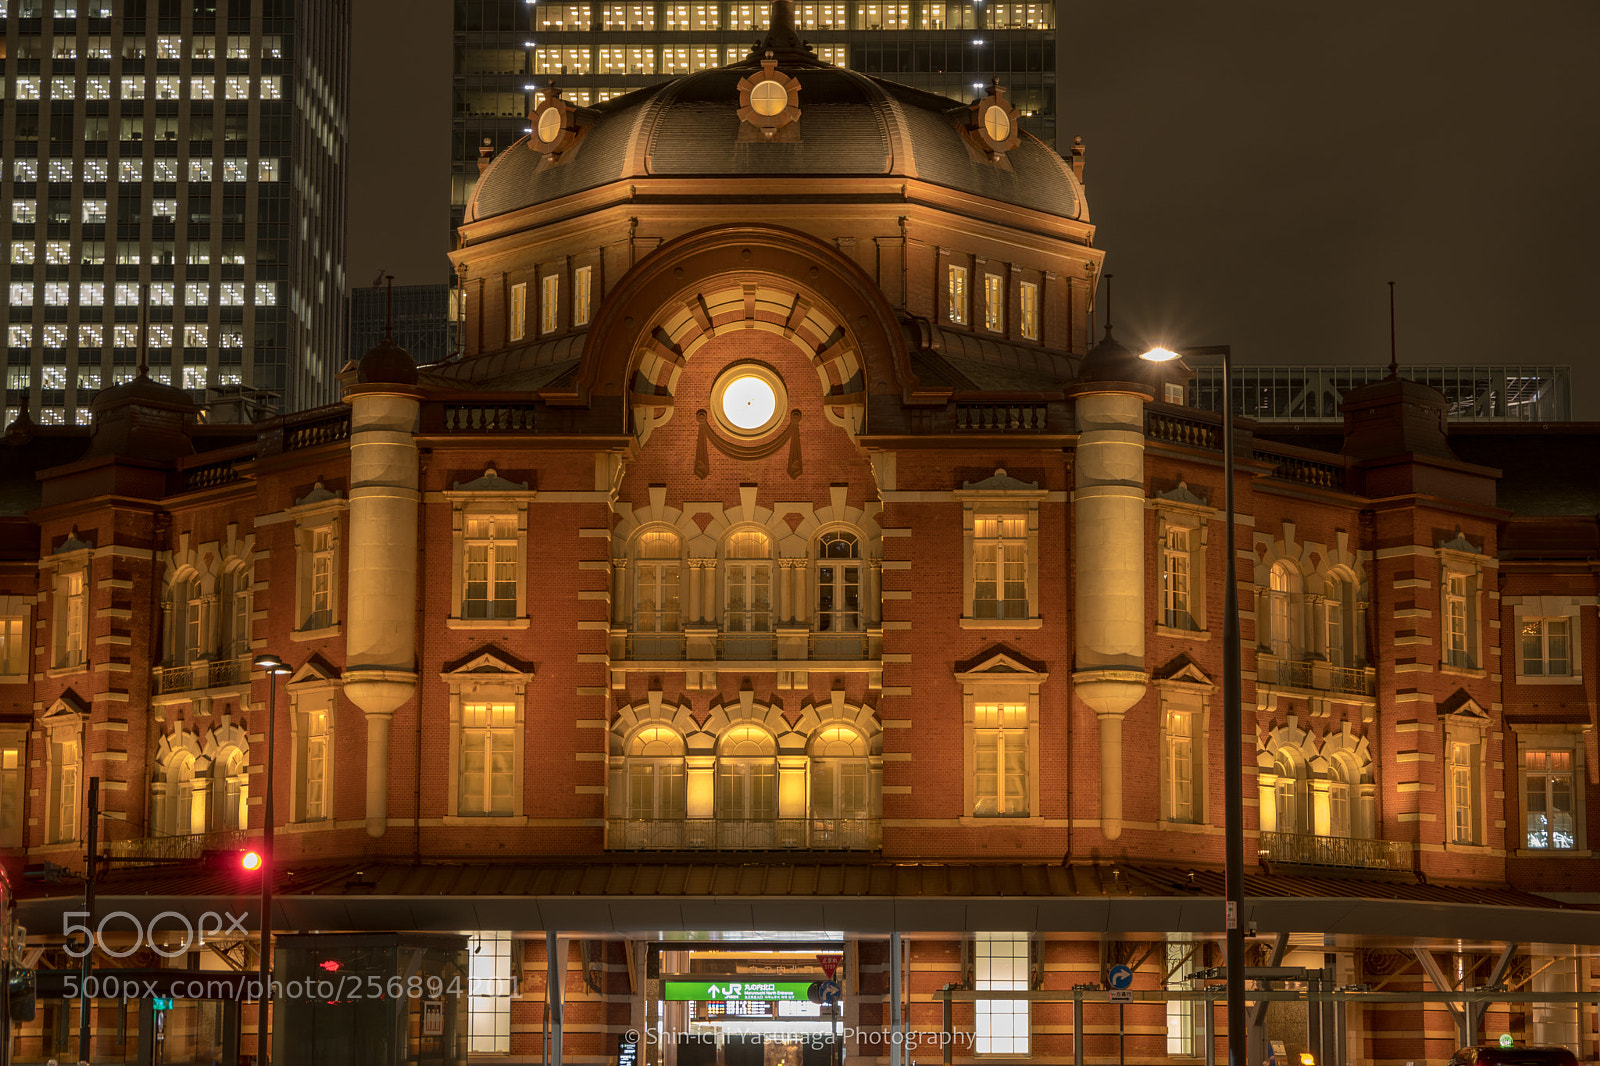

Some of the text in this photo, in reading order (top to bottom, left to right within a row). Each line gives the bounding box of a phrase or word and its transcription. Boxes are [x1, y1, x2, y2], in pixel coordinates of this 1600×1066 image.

[722, 984, 742, 995] JR
[744, 983, 775, 991] 丸の内北口
